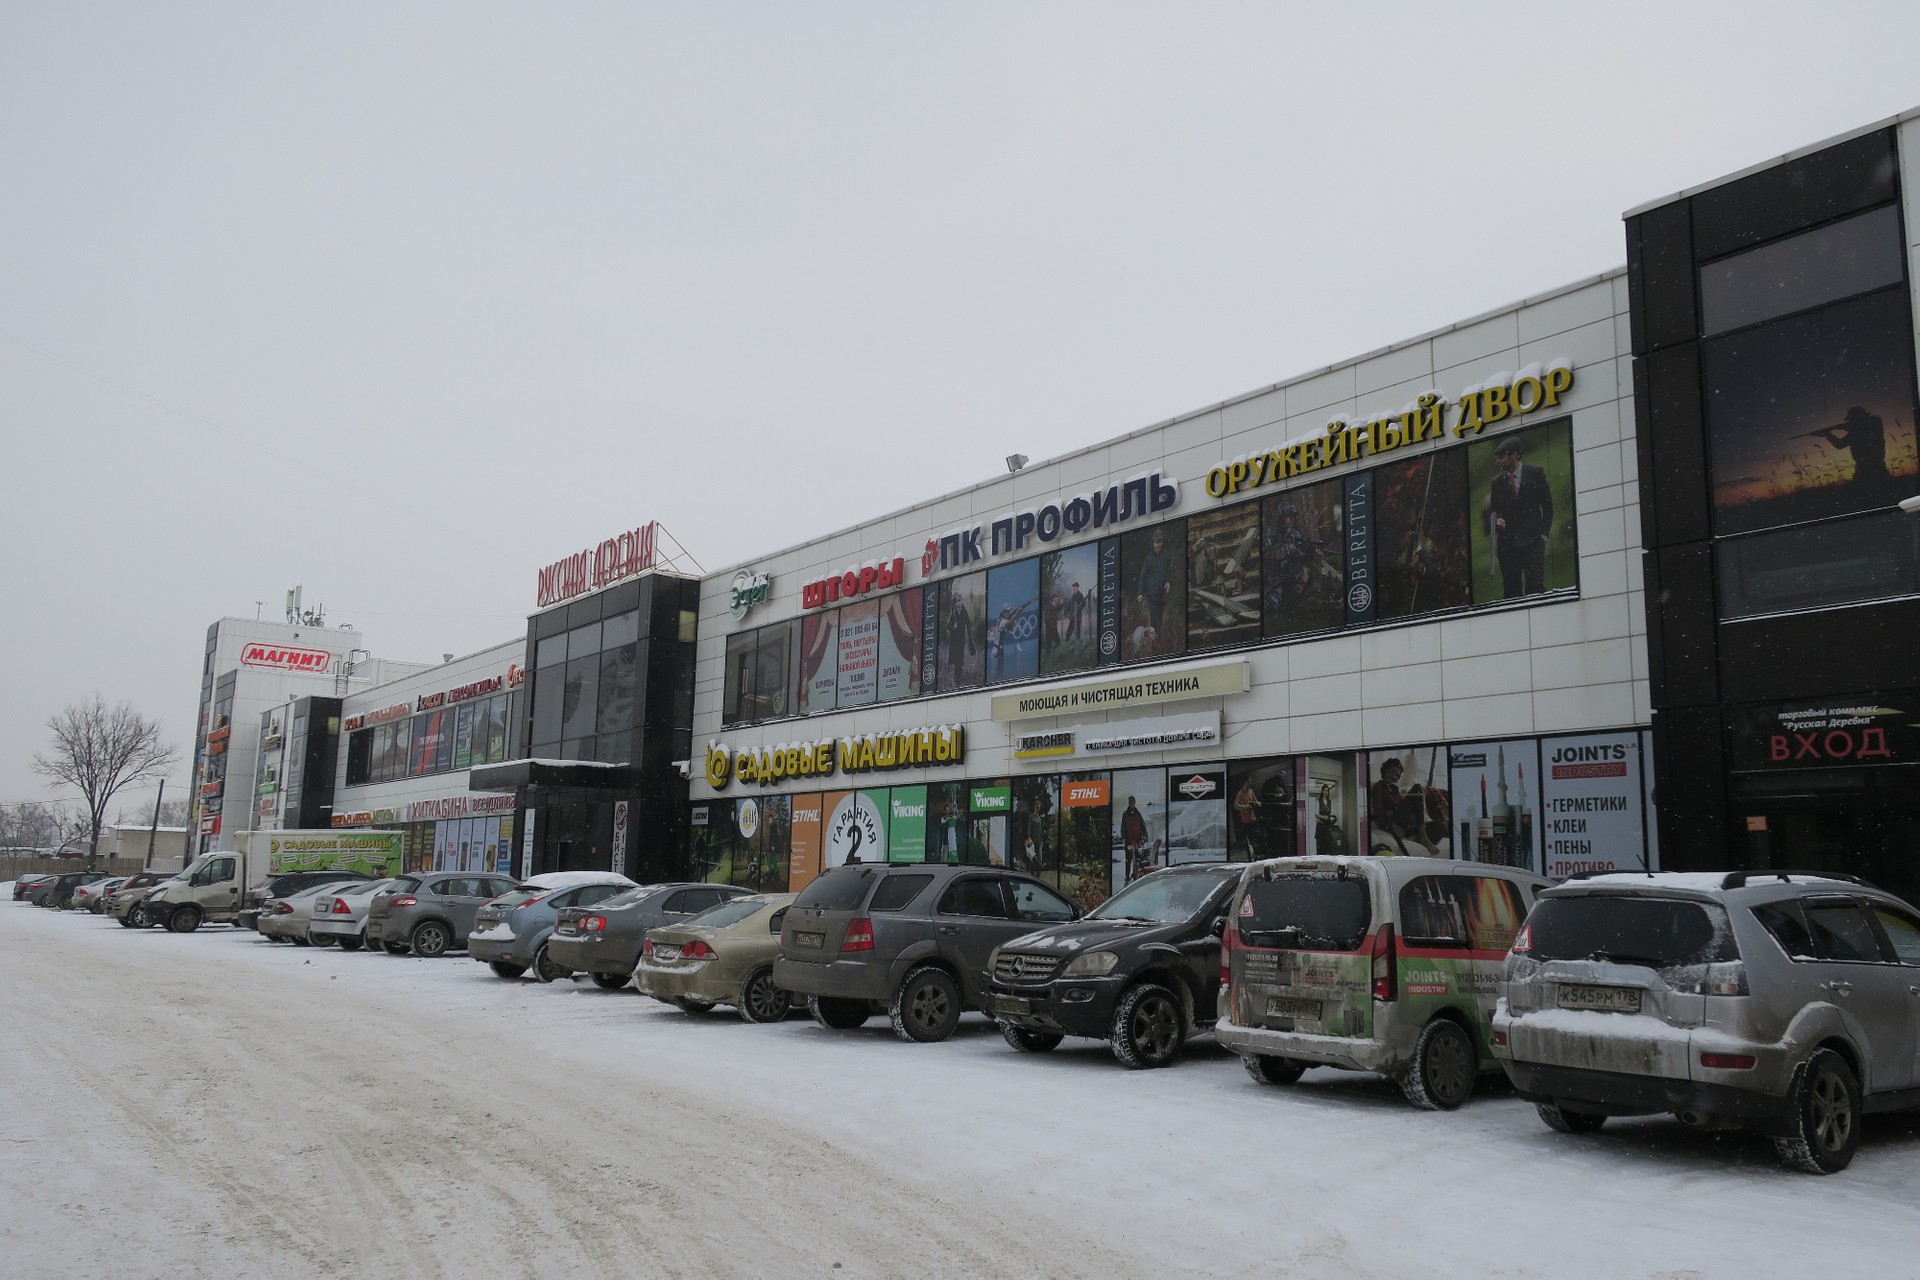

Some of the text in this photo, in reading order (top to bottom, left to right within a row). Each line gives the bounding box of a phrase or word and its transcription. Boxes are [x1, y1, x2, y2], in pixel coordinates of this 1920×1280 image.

[1205, 367, 1575, 498] ОРУЖЕЙНЫЙ ДВОР
[941, 473, 1179, 570] ПК ПРОФИЛЬ
[1350, 482, 1367, 582] BERETTA
[802, 557, 904, 610] ШТОРЫ
[1102, 545, 1116, 628] BERETTA
[924, 591, 935, 661] BERETTA
[247, 648, 325, 667] МАГНИТ
[1019, 676, 1200, 713] МОЮЩАЯ И ЧИСТЯЩАЯ ТЕХНИКА
[1778, 704, 1879, 720] торговый комплекс
[1770, 727, 1891, 761] ВХОД
[736, 728, 964, 784] САДОВЫЕ МАШИНЫ
[1558, 765, 1622, 778] INDUSTRY
[975, 794, 1005, 808] VIKING
[1070, 788, 1100, 800] STIHL
[893, 803, 924, 817] VIKING
[1553, 796, 1627, 812] ГЕРМЕТИКИ
[792, 809, 819, 823] STIHL
[832, 806, 877, 845] ГАРАНТИЯ
[1554, 819, 1587, 834] КЛЕИ
[283, 839, 392, 849] САДОВЫЕ МАШИНЫ
[1555, 840, 1592, 854] ПЕНЫ
[1408, 984, 1446, 993] INDUSTRY
